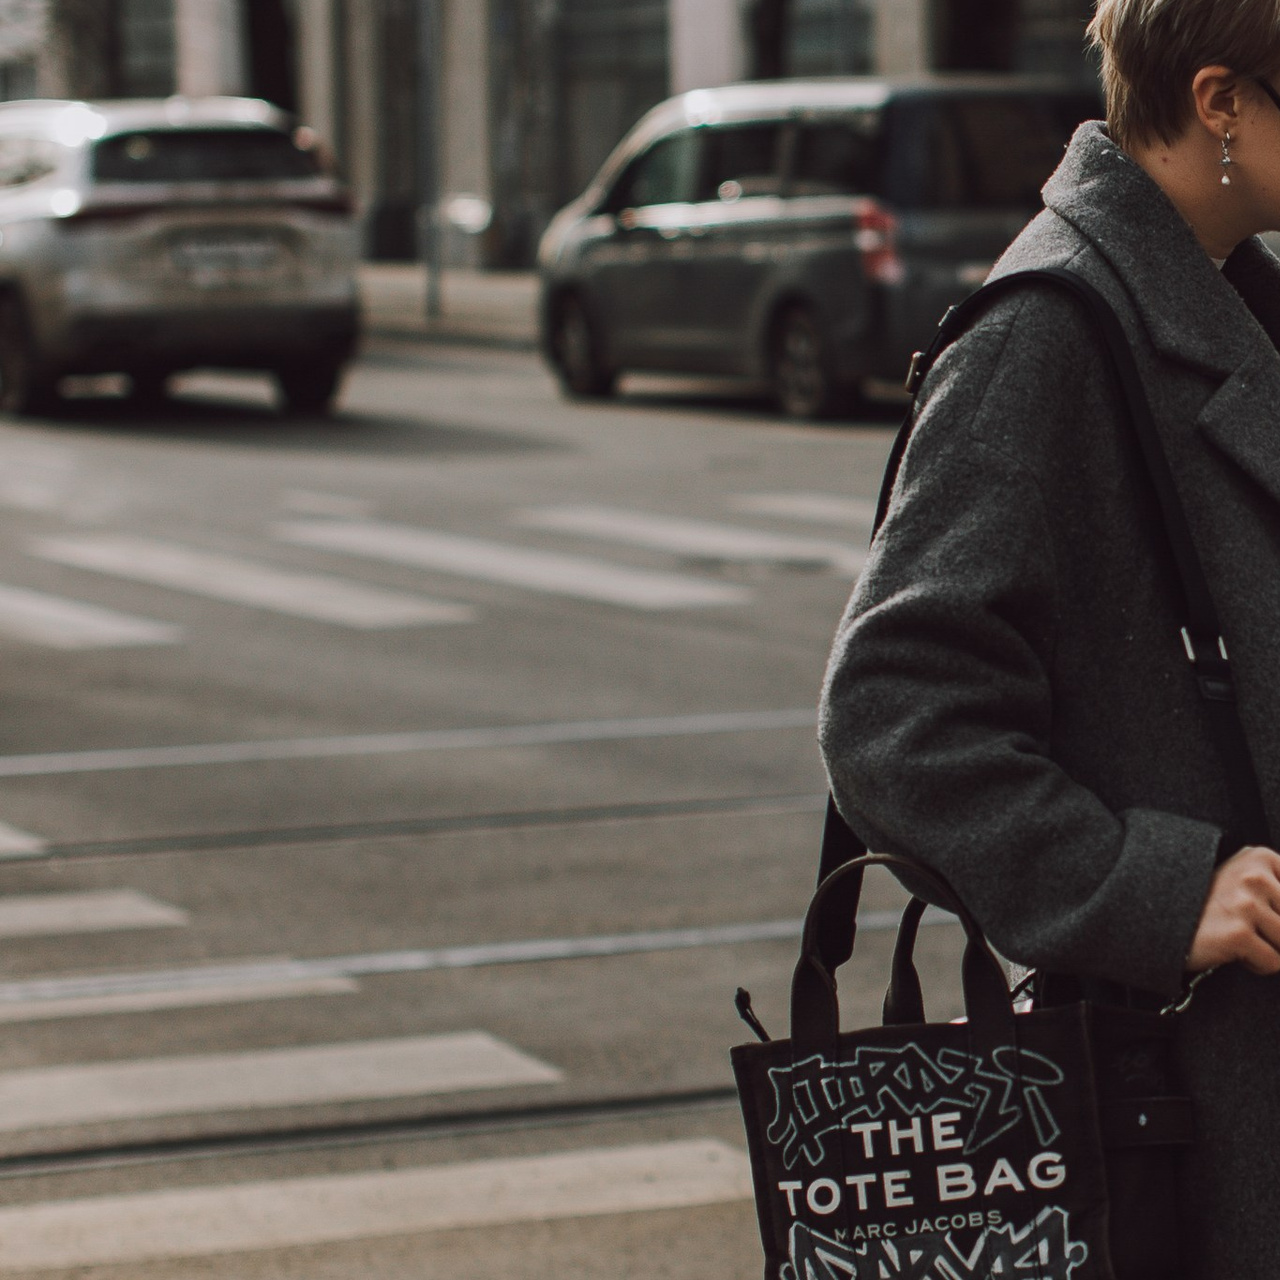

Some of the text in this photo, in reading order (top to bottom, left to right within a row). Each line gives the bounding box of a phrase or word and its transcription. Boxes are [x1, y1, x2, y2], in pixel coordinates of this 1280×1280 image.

[851, 1111, 964, 1158] THE
[778, 1152, 1066, 1216] TOTE BAG
[835, 1210, 1002, 1241] MARC JACOBS
